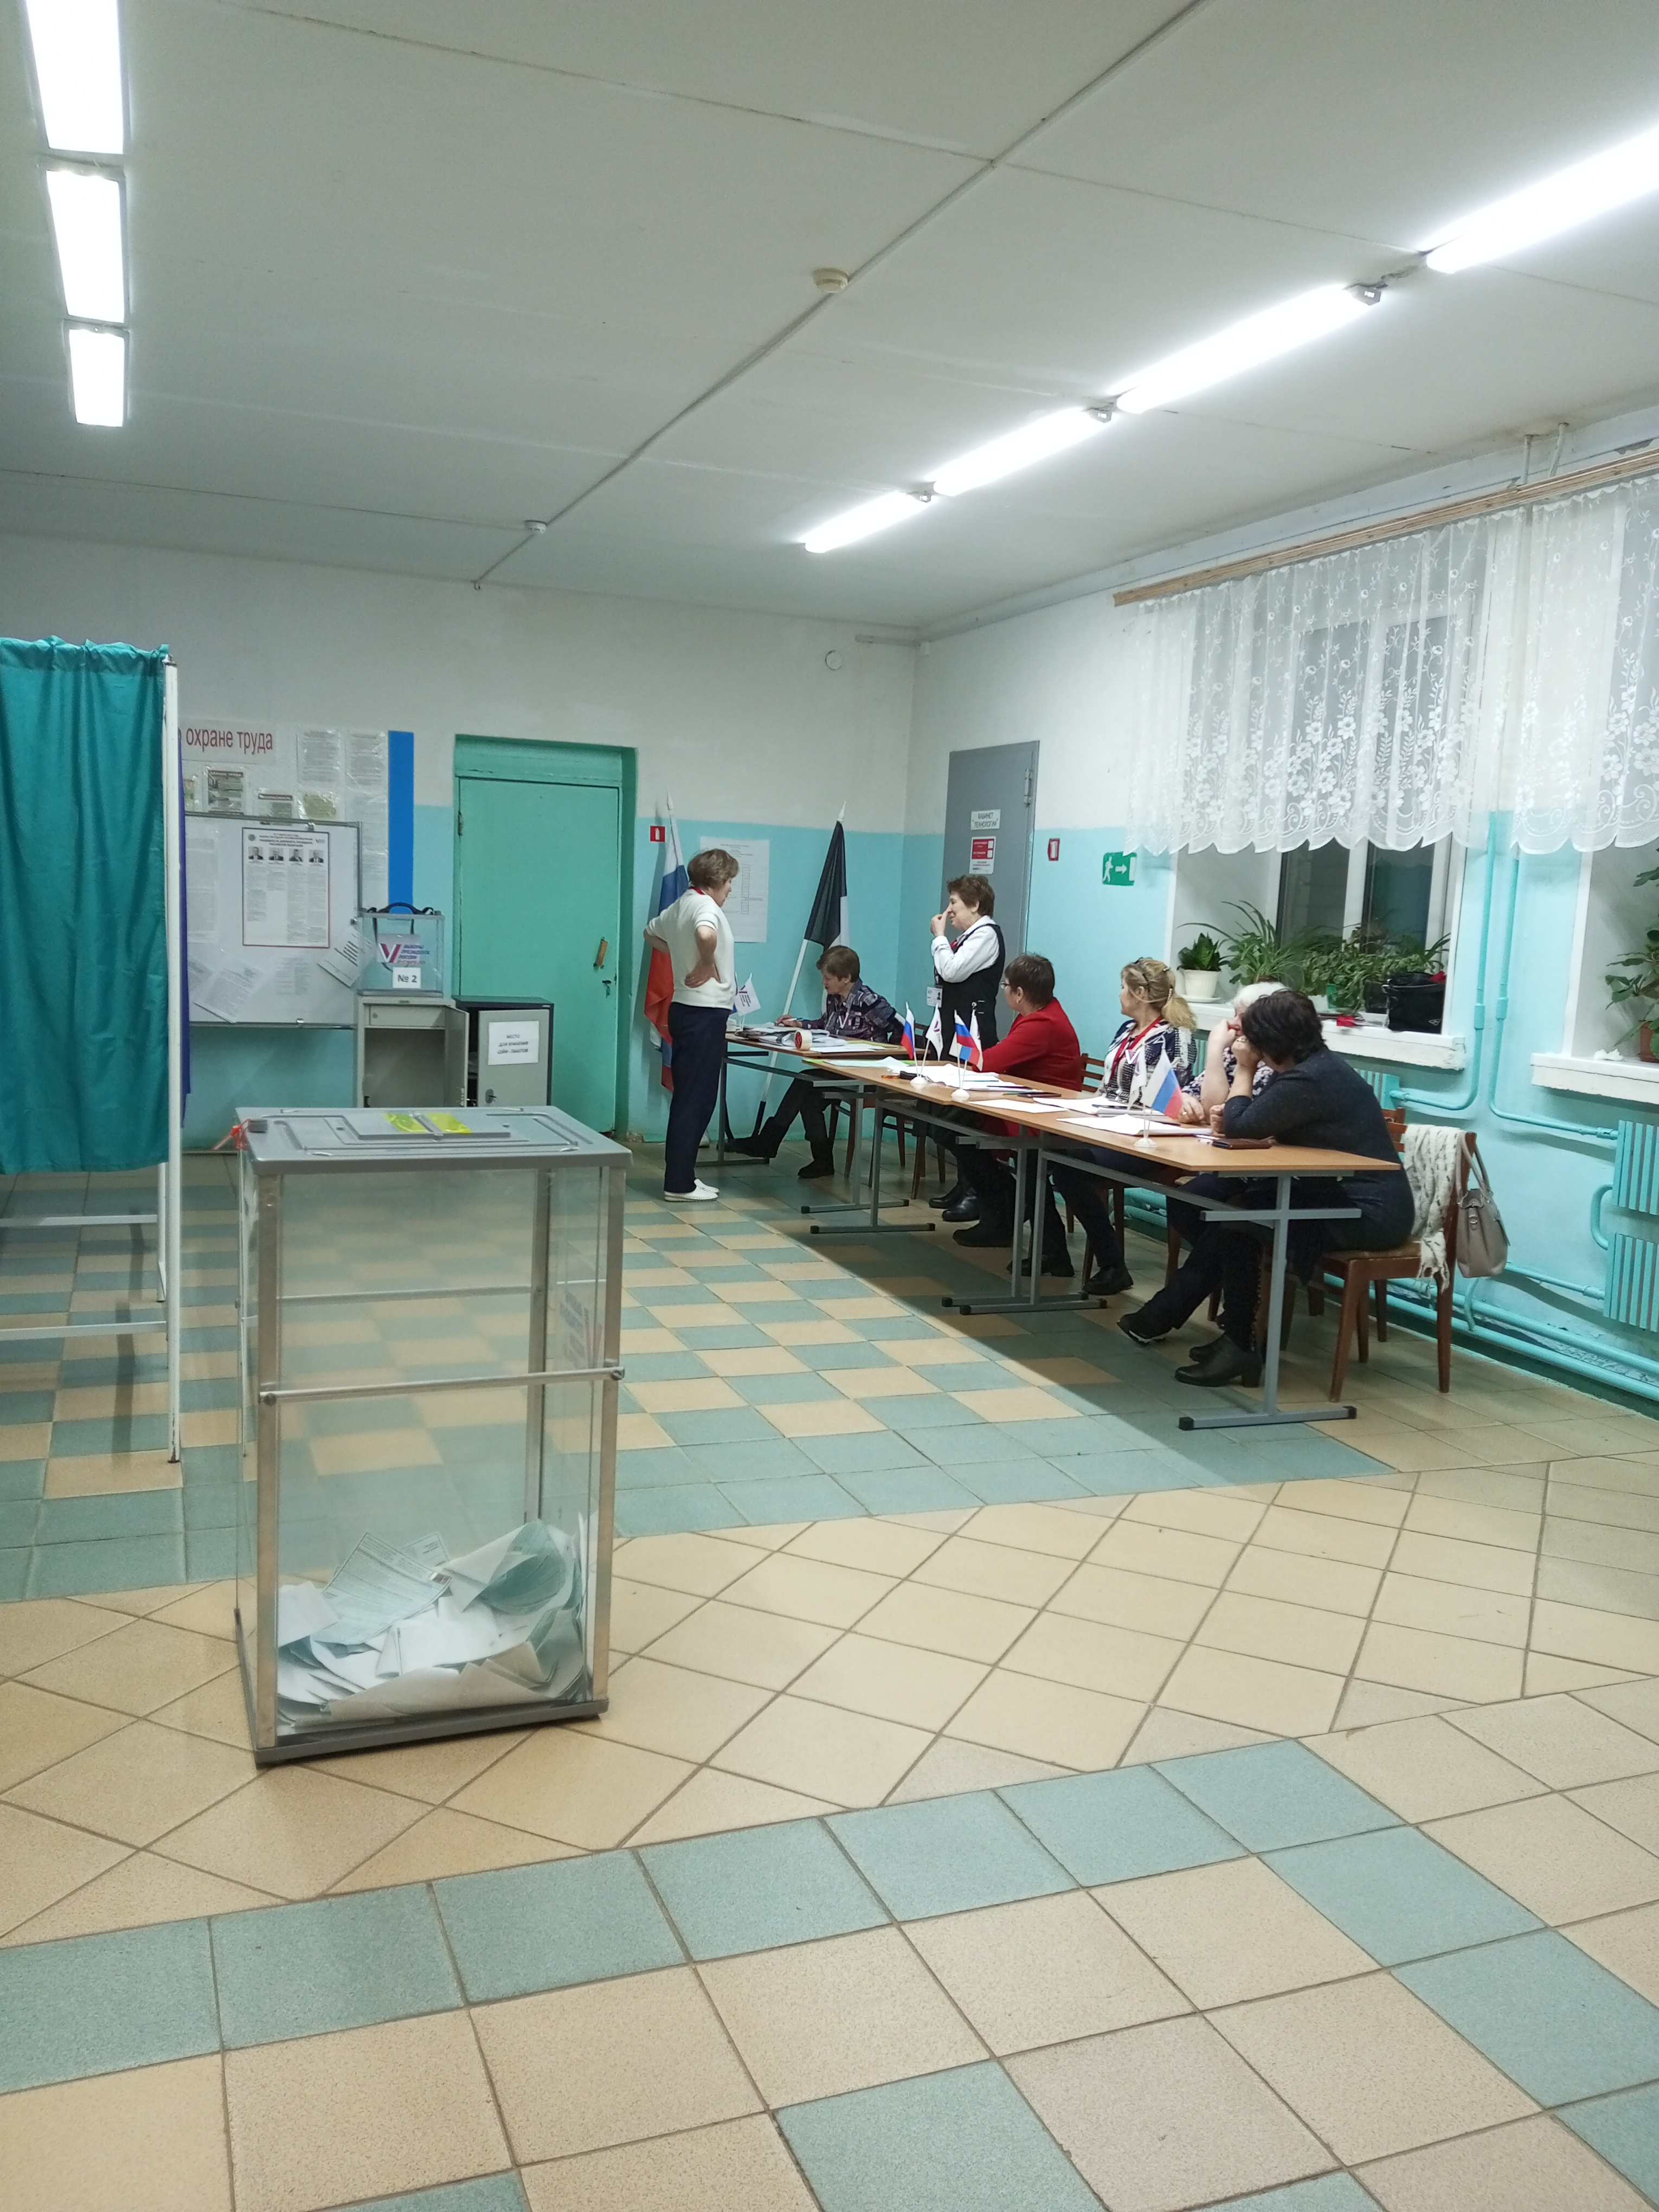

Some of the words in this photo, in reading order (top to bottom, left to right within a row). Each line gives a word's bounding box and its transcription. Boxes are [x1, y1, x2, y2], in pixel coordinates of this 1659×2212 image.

[186, 728, 233, 753] охране
[237, 731, 273, 755] труда
[397, 974, 409, 982] №
[411, 975, 417, 983] 2
